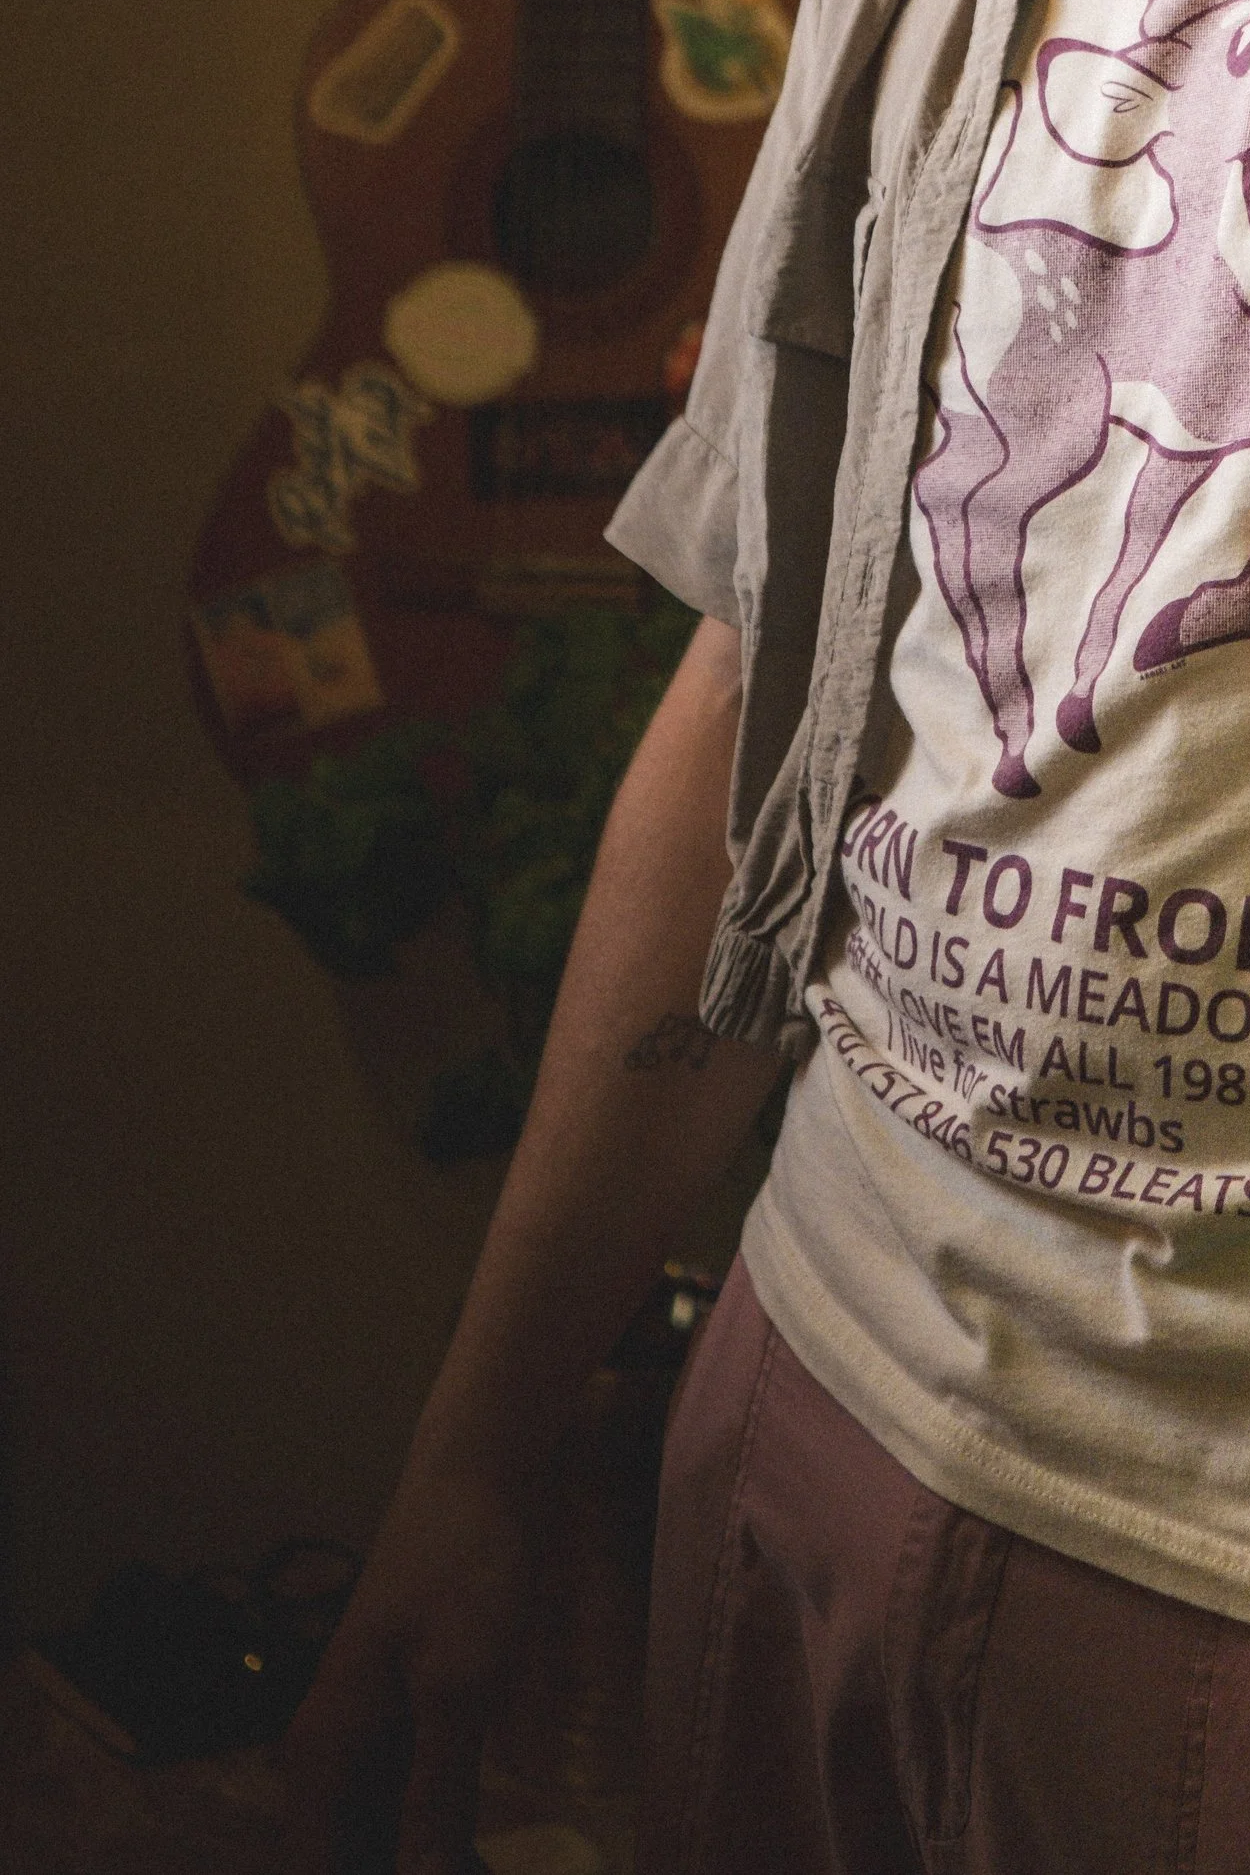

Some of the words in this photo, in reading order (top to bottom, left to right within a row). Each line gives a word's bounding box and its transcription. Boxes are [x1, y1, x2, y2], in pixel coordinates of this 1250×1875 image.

[840, 794, 919, 902] ORN
[942, 839, 1033, 930] TO
[850, 883, 918, 971] ORLD
[930, 931, 970, 988] IS
[975, 948, 1009, 1004] A
[953, 1048, 989, 1103] for
[986, 1082, 1183, 1153] strawbs
[971, 1014, 1026, 1073] EM
[1039, 1035, 1134, 1091] ALL
